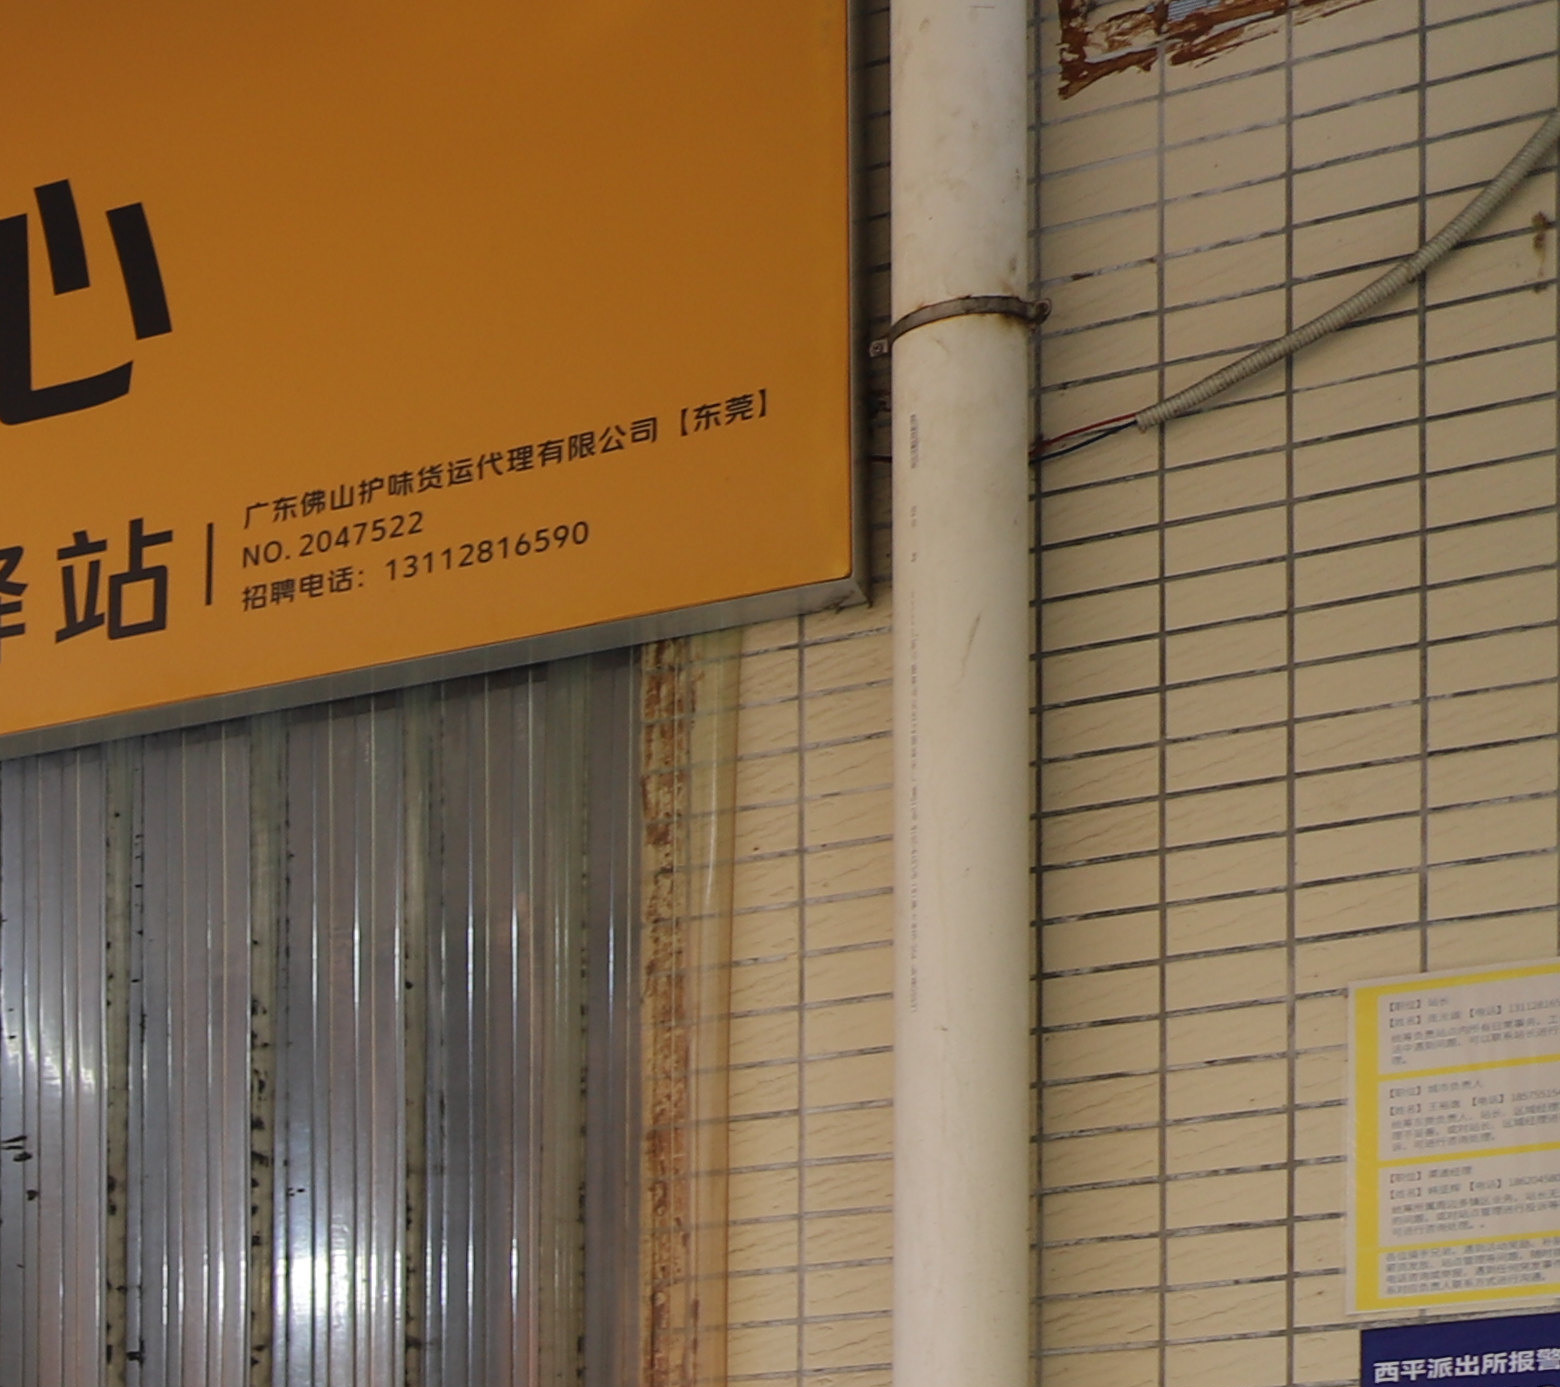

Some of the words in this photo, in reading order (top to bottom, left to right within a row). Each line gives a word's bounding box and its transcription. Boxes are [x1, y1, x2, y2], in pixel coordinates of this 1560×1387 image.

[1373, 1348, 1560, 1384] 西平派出所报警
